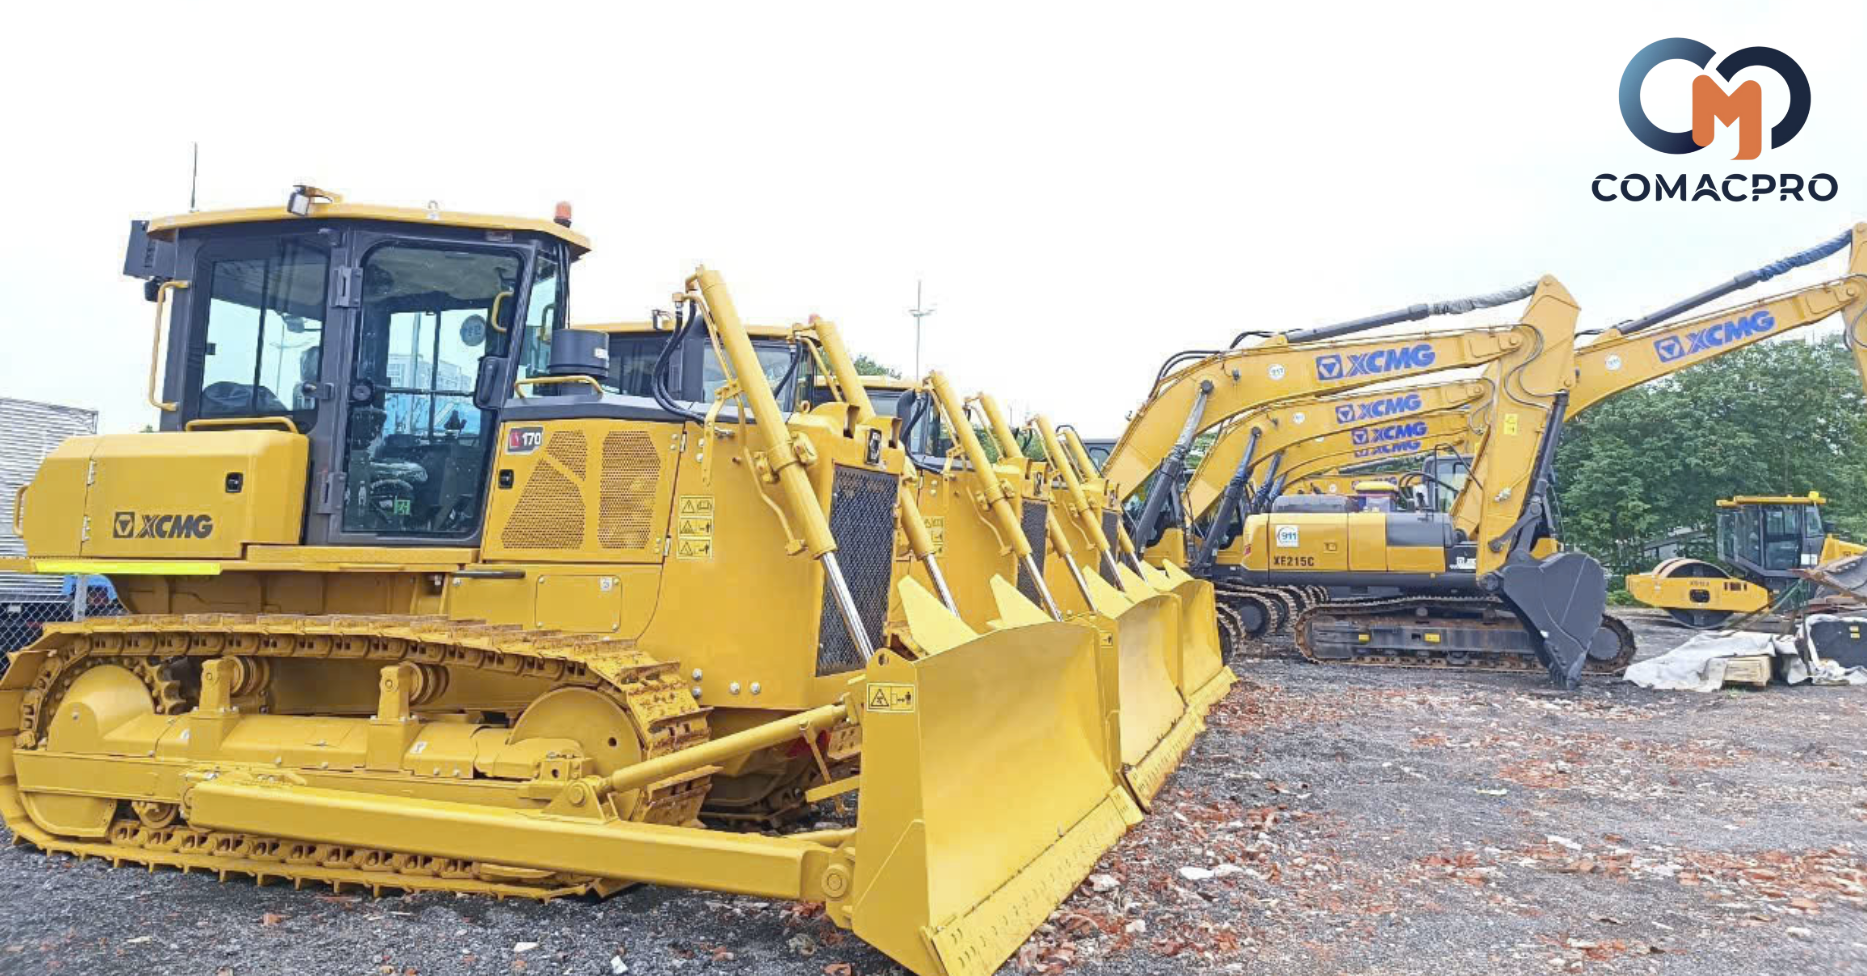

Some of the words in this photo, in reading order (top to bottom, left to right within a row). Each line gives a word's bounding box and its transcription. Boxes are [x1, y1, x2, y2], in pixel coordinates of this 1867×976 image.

[1686, 311, 1775, 354] XCMG
[1346, 344, 1436, 377] XCMG
[1358, 394, 1422, 420] XCMG
[522, 432, 541, 446] 170
[1371, 422, 1428, 443] XCMG
[136, 514, 213, 539] XCMG
[1281, 531, 1298, 541] 911
[1274, 556, 1315, 567] XE215C
